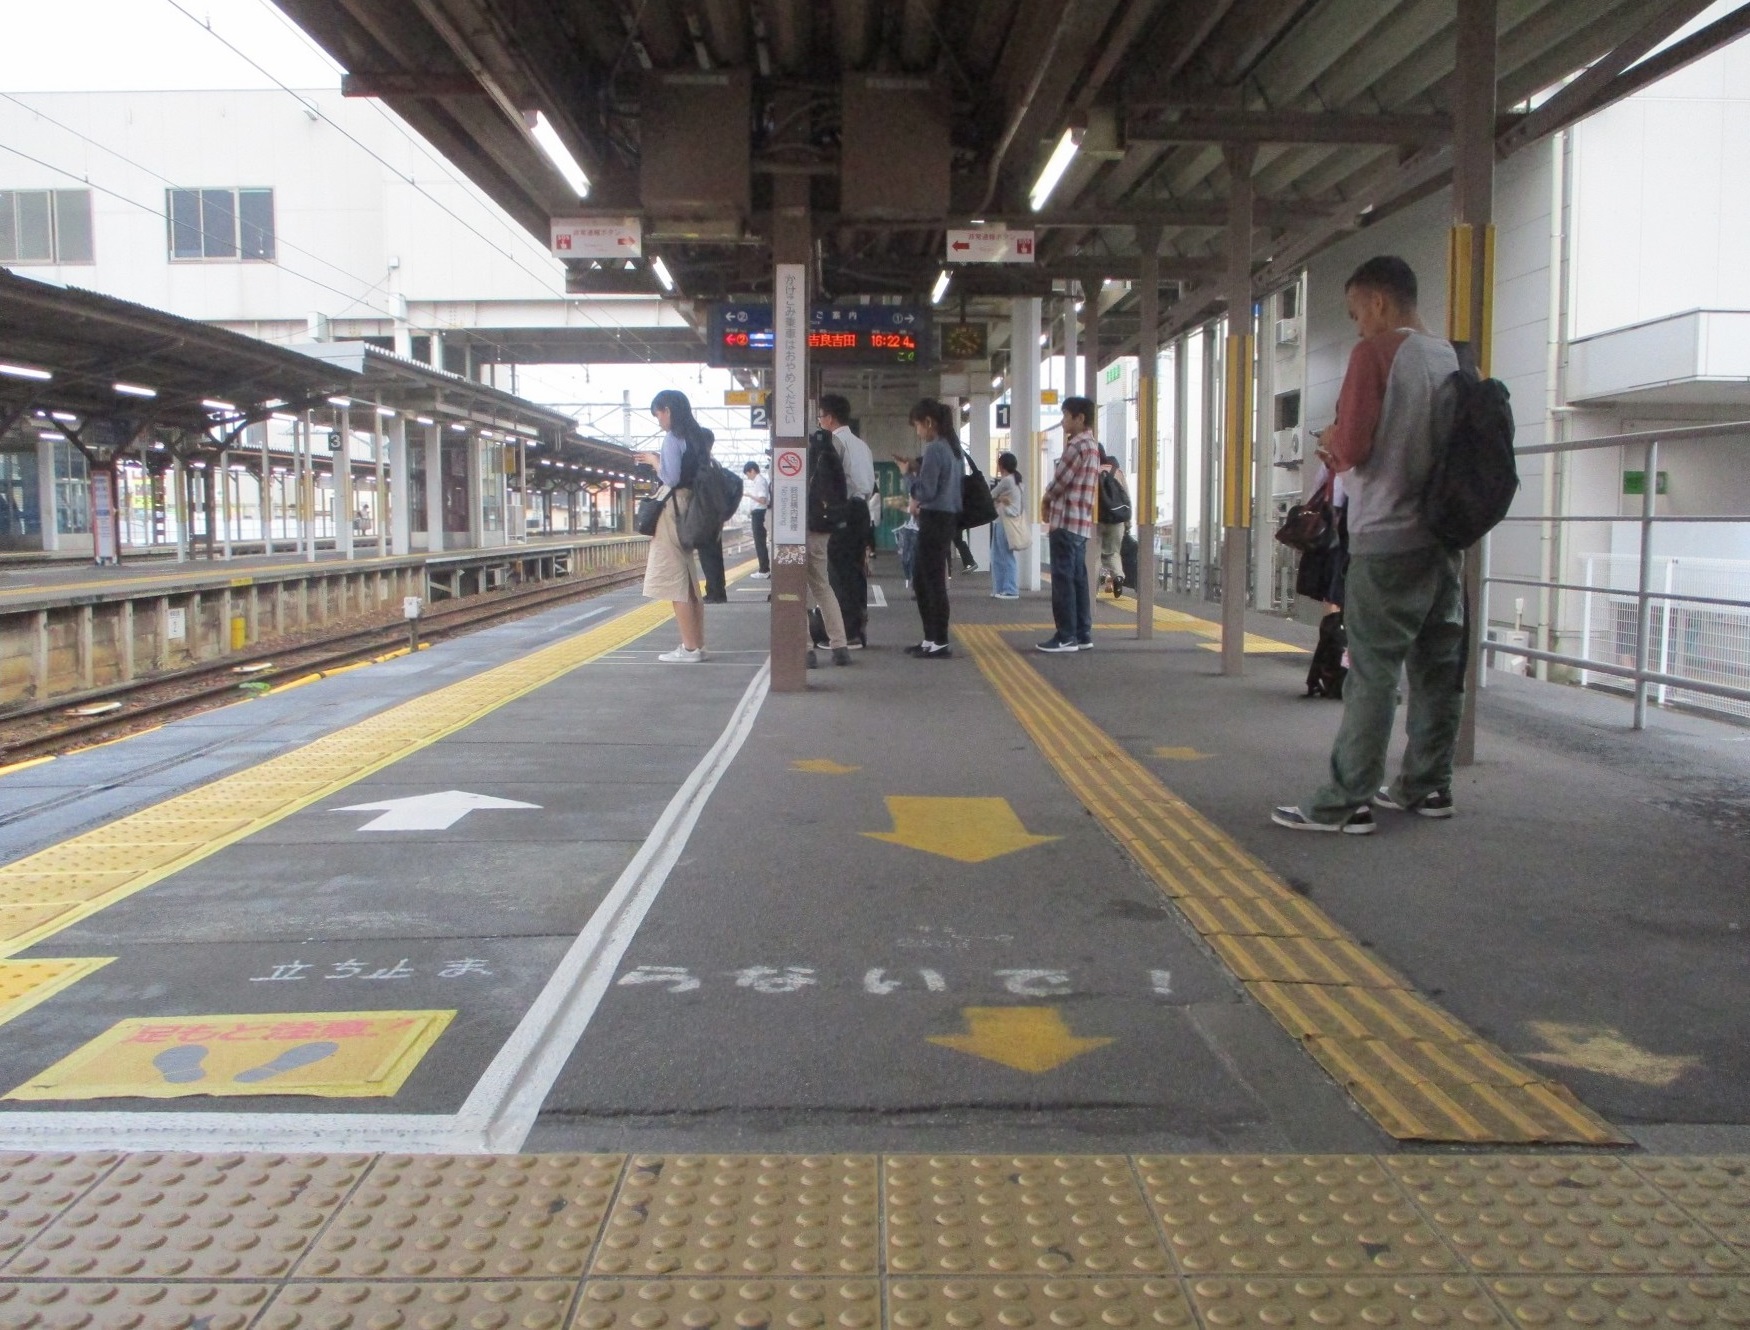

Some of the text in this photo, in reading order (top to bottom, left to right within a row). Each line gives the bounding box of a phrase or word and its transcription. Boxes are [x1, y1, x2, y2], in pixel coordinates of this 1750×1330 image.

[784, 274, 796, 424] かけこみ乗車はおやめください
[871, 335, 900, 348] 16:22
[753, 408, 767, 425] 2
[999, 408, 1008, 424] 1
[331, 434, 341, 448] 3
